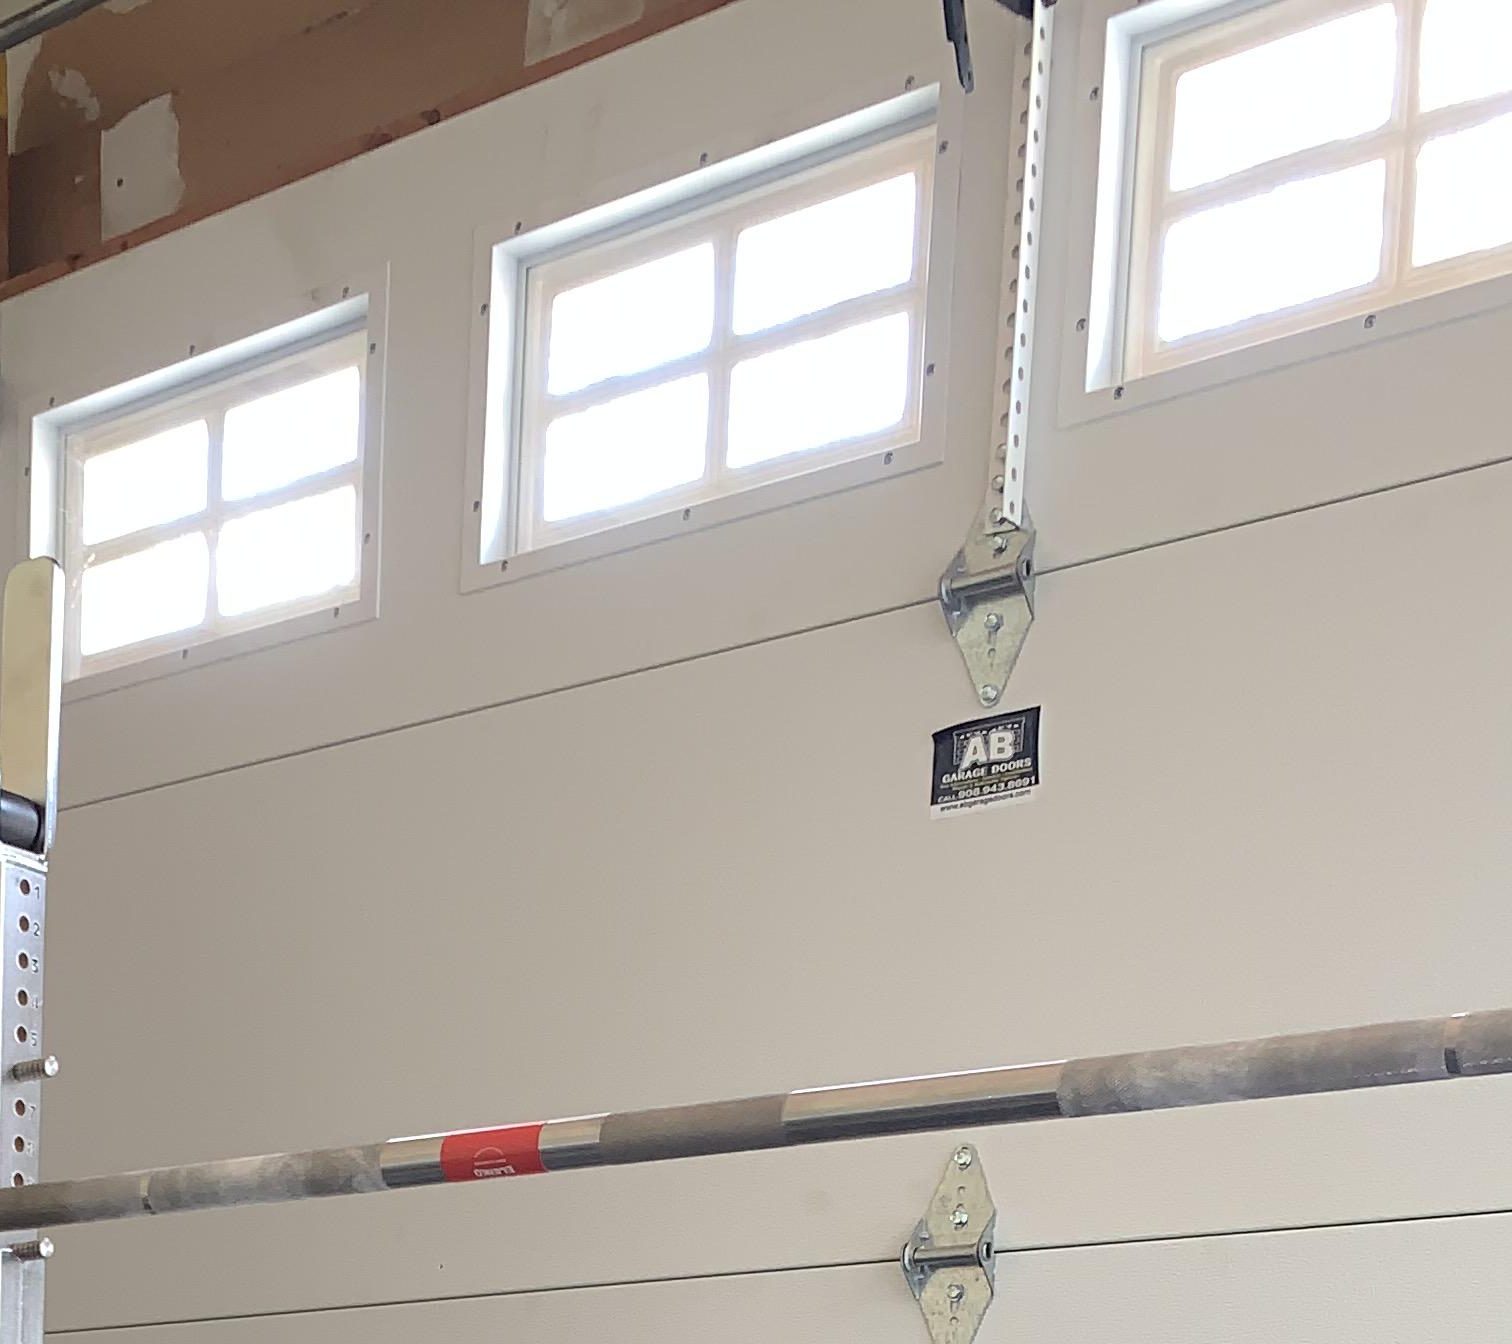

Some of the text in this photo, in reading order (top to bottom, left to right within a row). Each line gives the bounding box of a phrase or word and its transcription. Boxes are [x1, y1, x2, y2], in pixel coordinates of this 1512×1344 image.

[960, 731, 1014, 769] AB
[942, 766, 987, 784] GARAGE
[991, 757, 1032, 774] DOORS
[32, 922, 40, 936] 2
[31, 959, 39, 972] 3
